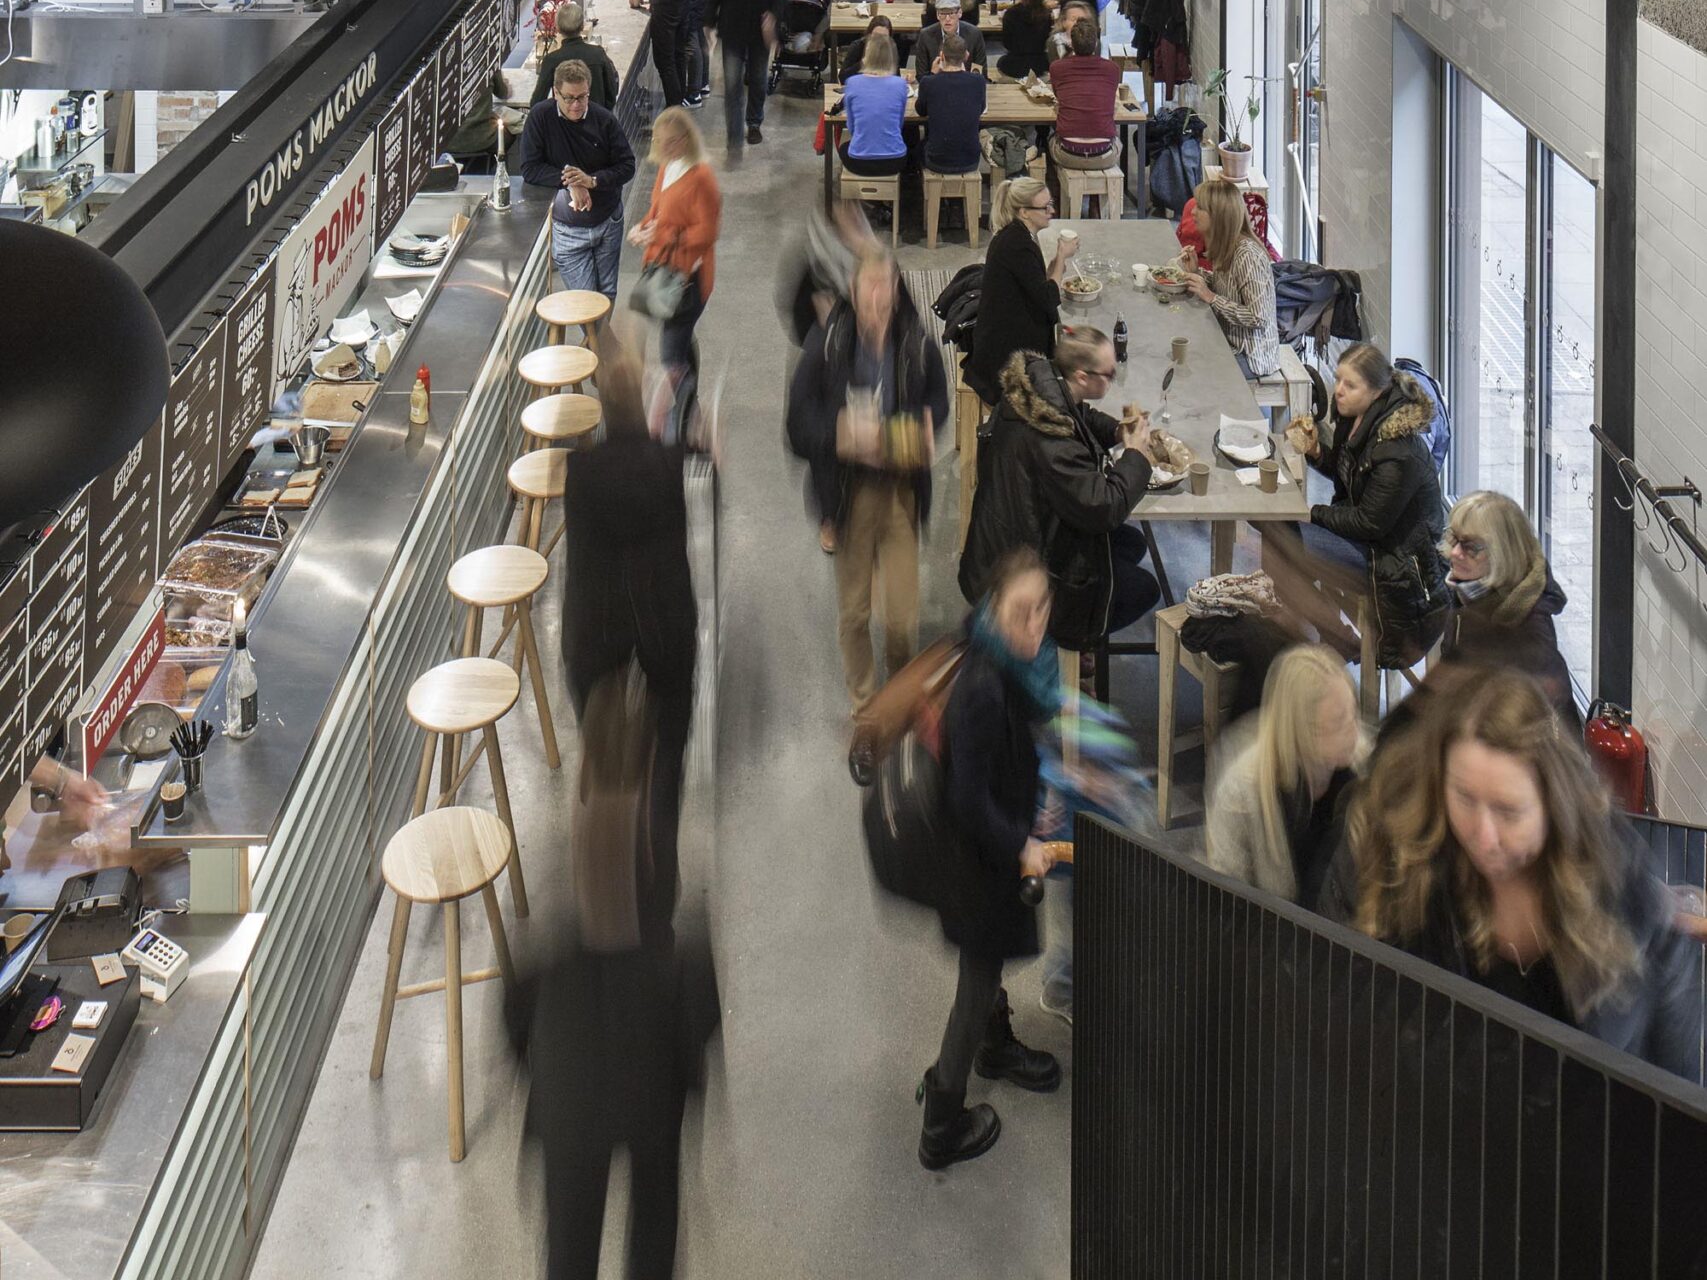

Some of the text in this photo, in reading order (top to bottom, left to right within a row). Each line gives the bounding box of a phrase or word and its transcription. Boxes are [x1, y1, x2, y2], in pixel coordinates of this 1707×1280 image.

[246, 50, 377, 226] POMS MACKOR
[312, 172, 366, 288] POMS
[325, 248, 353, 300] MACKOR
[237, 292, 267, 344] GRILLED
[237, 316, 264, 368] CHEESE
[116, 446, 140, 494] SIDES
[119, 491, 137, 519] POTATOES
[93, 629, 159, 748] ORDER HERE
